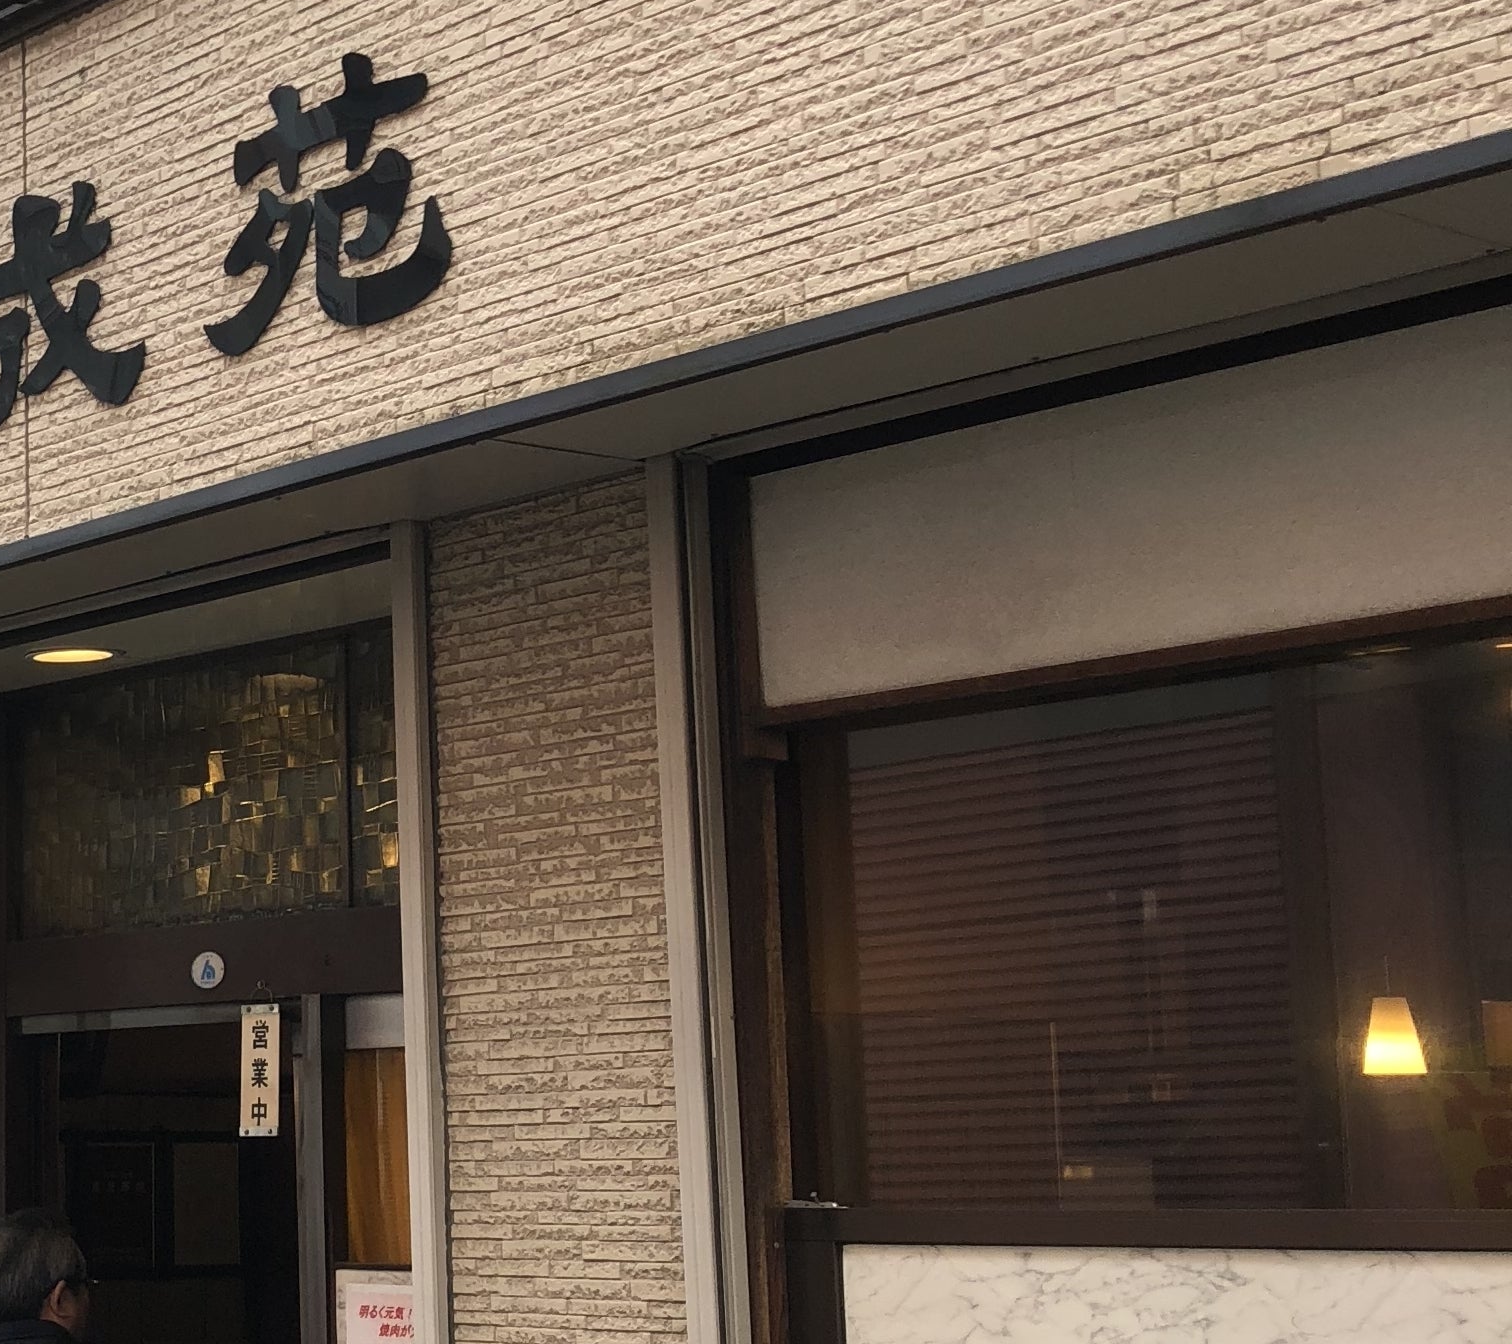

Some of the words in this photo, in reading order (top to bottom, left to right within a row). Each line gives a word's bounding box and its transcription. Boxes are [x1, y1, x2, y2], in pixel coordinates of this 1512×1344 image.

[251, 1019, 269, 1126] 営業中
[378, 1323, 415, 1338] 焼肉が
